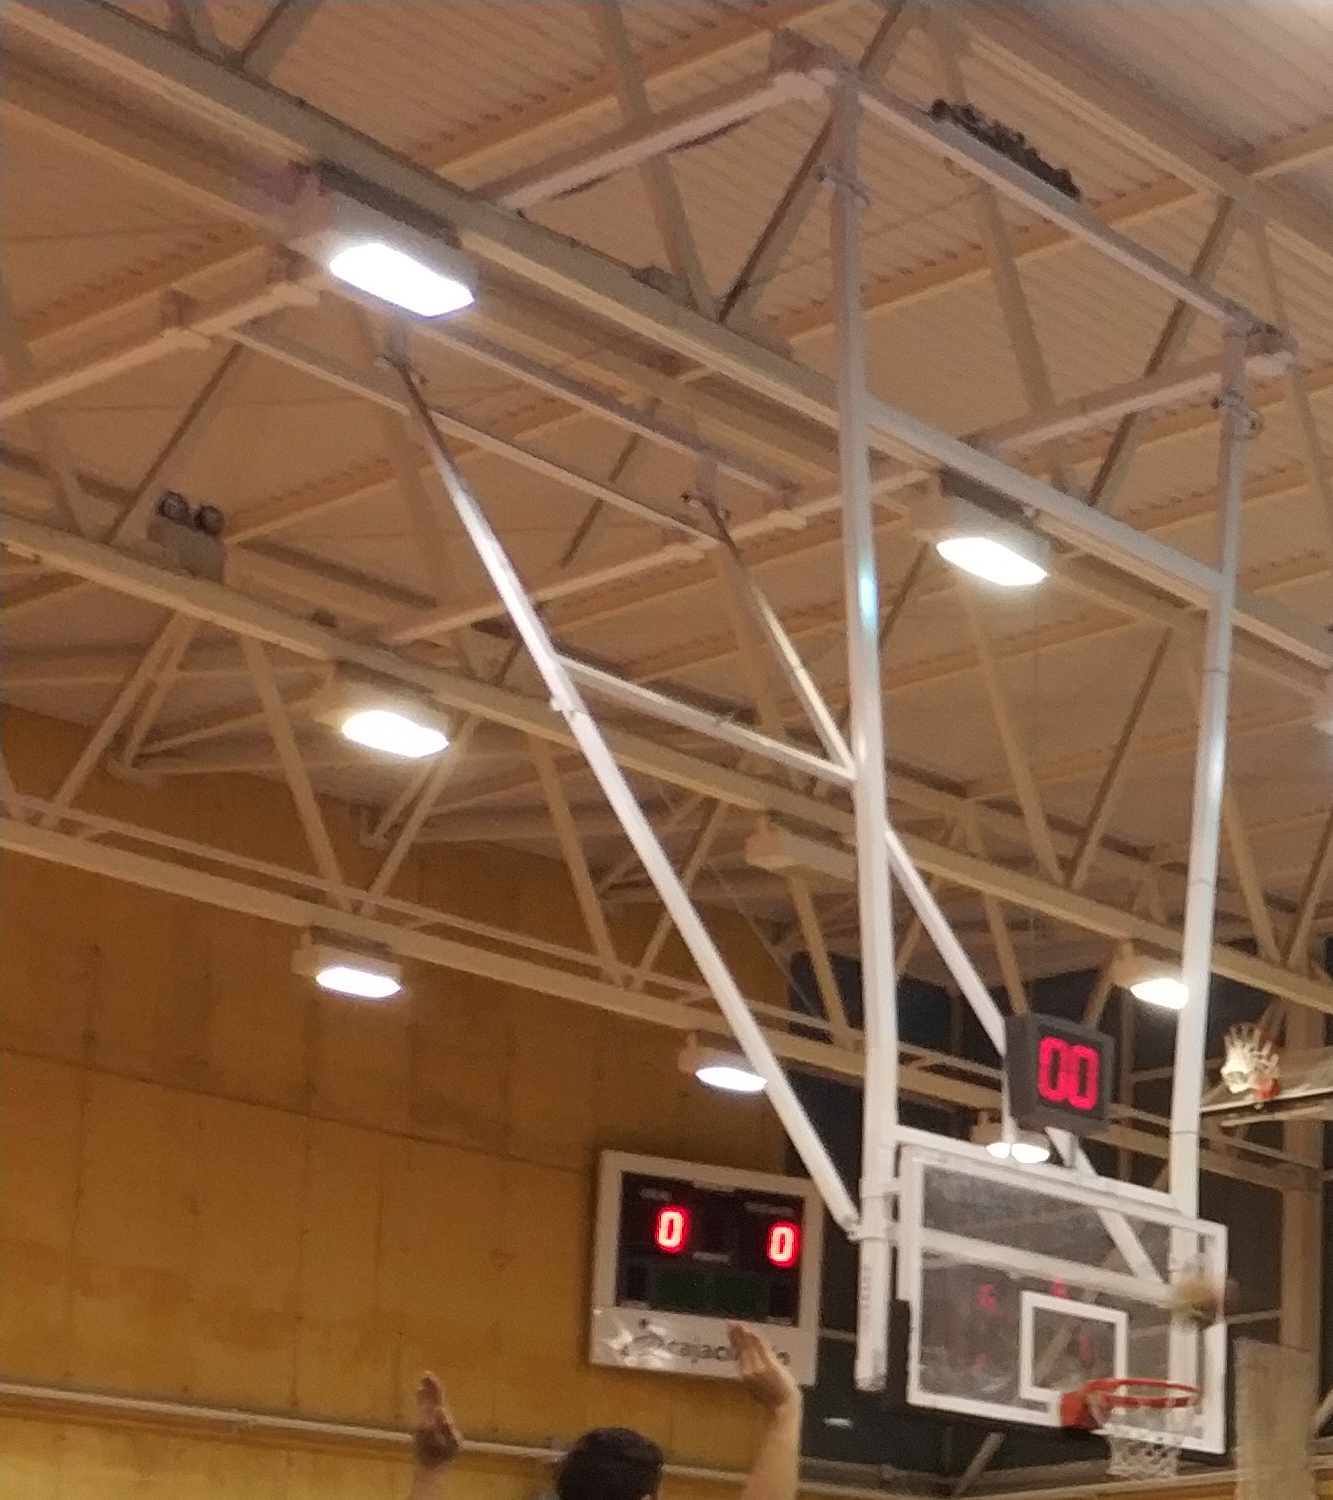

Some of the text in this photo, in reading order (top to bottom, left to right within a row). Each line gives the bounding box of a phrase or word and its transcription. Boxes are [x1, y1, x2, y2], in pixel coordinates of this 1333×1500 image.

[1038, 1036, 1099, 1110] 00
[656, 1208, 686, 1251] 0
[767, 1223, 799, 1266] 0
